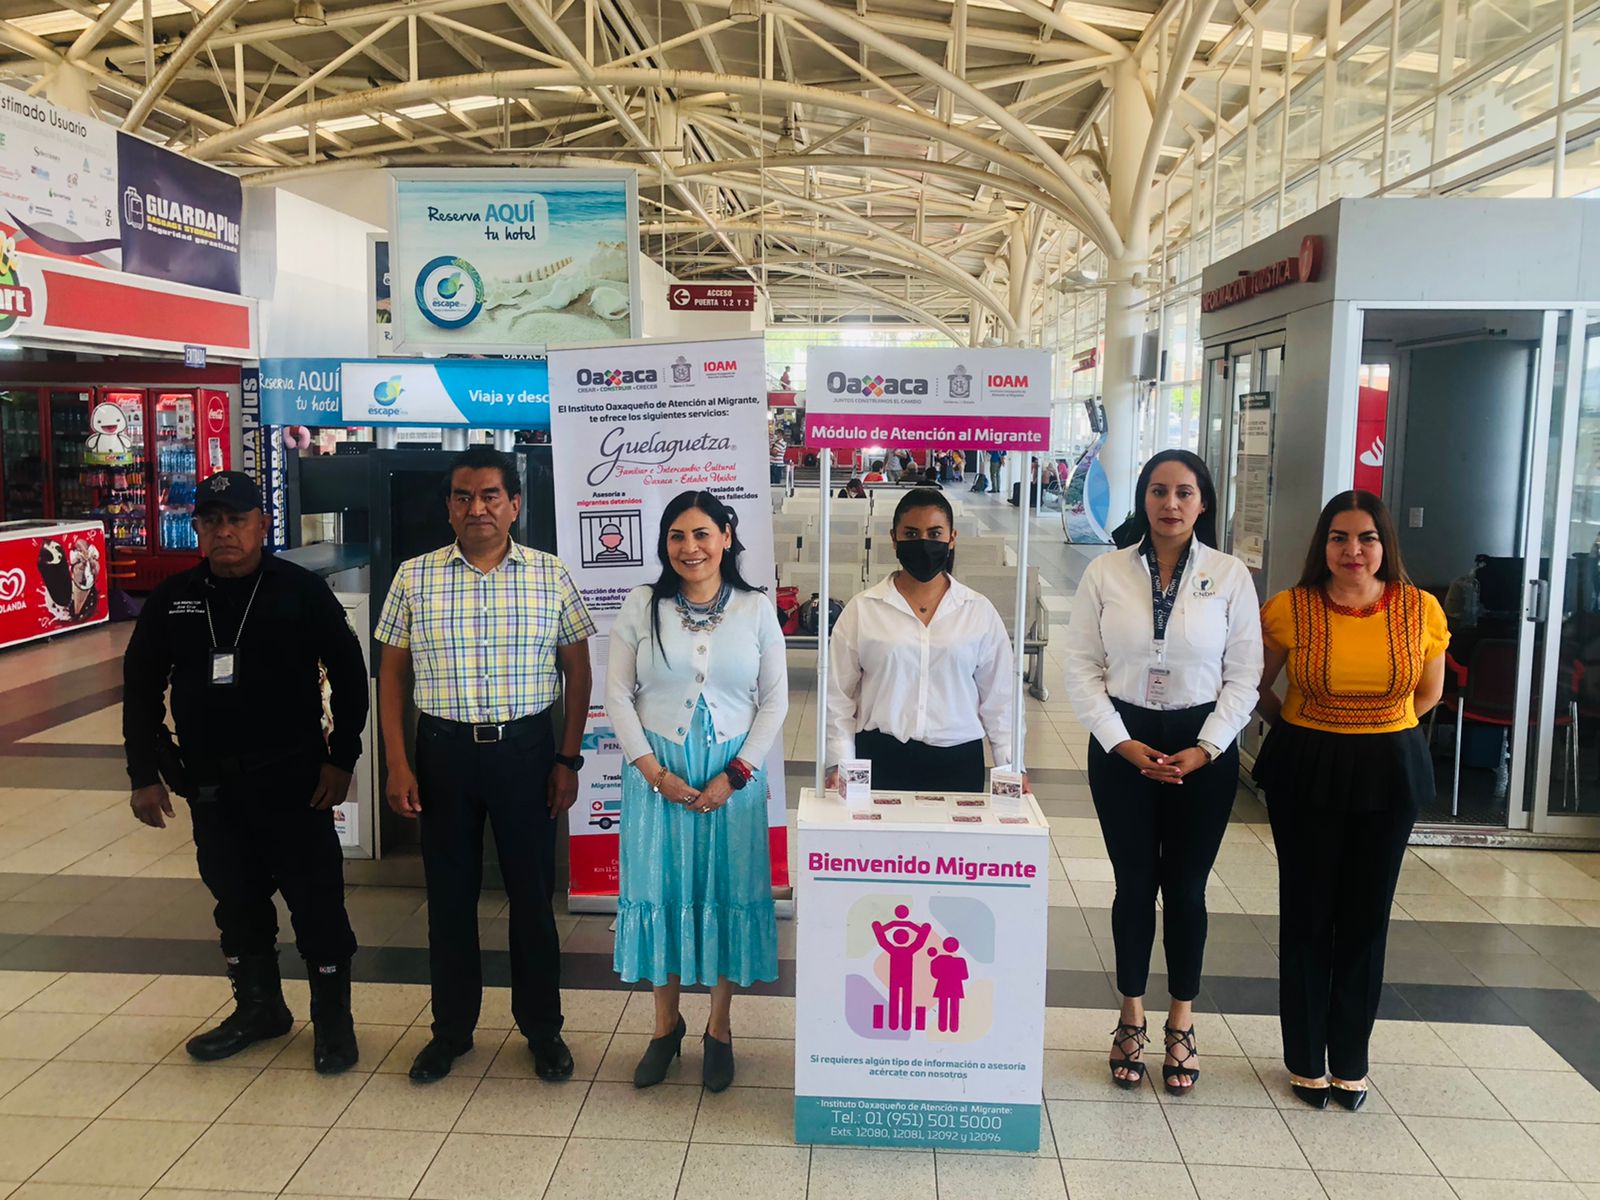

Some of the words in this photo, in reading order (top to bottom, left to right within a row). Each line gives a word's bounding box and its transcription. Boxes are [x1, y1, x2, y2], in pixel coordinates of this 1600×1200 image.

[49, 109, 87, 138] Usuario
[428, 206, 481, 222] Reserva
[485, 200, 535, 224] AQUÍ
[147, 223, 192, 241] Seguridad
[194, 237, 238, 253] garantizada
[485, 226, 499, 241] tu
[505, 226, 536, 241] hotel
[707, 289, 732, 297] ACCESO
[432, 300, 460, 309] escape
[259, 373, 295, 390] Reserva
[298, 367, 341, 393] AQUÍ
[577, 368, 658, 386] Oaxaca
[703, 360, 737, 371] IOAM
[827, 371, 928, 397] Oaxaca
[987, 374, 1029, 388] IOAM
[296, 396, 307, 410] tu
[312, 396, 339, 412] hotel
[468, 390, 504, 405] Viaja
[506, 393, 515, 406] y
[558, 405, 567, 413] El
[568, 404, 605, 413] Instituto
[605, 401, 655, 411] Oaxaqueño
[656, 400, 667, 408] de
[668, 398, 706, 408] Atención
[707, 397, 716, 406] al
[717, 396, 760, 407] Migrante,
[367, 408, 400, 417] escape
[589, 415, 598, 423] te
[599, 414, 627, 422] ofrece
[628, 413, 641, 421] los
[643, 410, 687, 421] siguientes
[688, 409, 729, 418] servicios:
[811, 425, 867, 440] Módulo
[870, 427, 888, 440] de
[890, 426, 956, 441] Atención
[958, 427, 972, 441] al
[974, 427, 1042, 444] Migrante
[615, 465, 648, 477] Familiar
[703, 461, 737, 472] Cultural
[643, 474, 673, 486] Oaxaca
[680, 474, 708, 485] Estados
[710, 471, 737, 482] Unidos
[592, 490, 620, 498] Asesoría
[610, 497, 642, 505] detenidos
[724, 492, 758, 500] fallecidos
[808, 852, 931, 875] Bienvenido
[935, 856, 1037, 880] Migrante
[810, 1054, 819, 1063] Si
[820, 1056, 864, 1065] requieres
[865, 1057, 891, 1067] algún
[892, 1057, 910, 1067] tipo
[911, 1058, 923, 1066] de
[924, 1058, 979, 1069] información
[987, 1062, 1026, 1071] asesoría
[869, 1068, 909, 1077] acércate
[909, 1070, 927, 1078] con
[927, 1070, 968, 1079] nosotros
[820, 1099, 857, 1108] Instituto
[858, 1100, 906, 1111] Oaxaqueño
[907, 1102, 919, 1110] de
[920, 1103, 958, 1112] Atención
[970, 1105, 1013, 1115] Migrante:
[865, 1111, 884, 1125] 01
[886, 1111, 924, 1128] (951)
[928, 1113, 956, 1128] 501
[959, 1115, 1002, 1130] 5000
[856, 1127, 890, 1139] 12080,
[927, 1130, 959, 1141] 12092
[960, 1133, 968, 1143] y
[969, 1132, 1001, 1142] 12096
